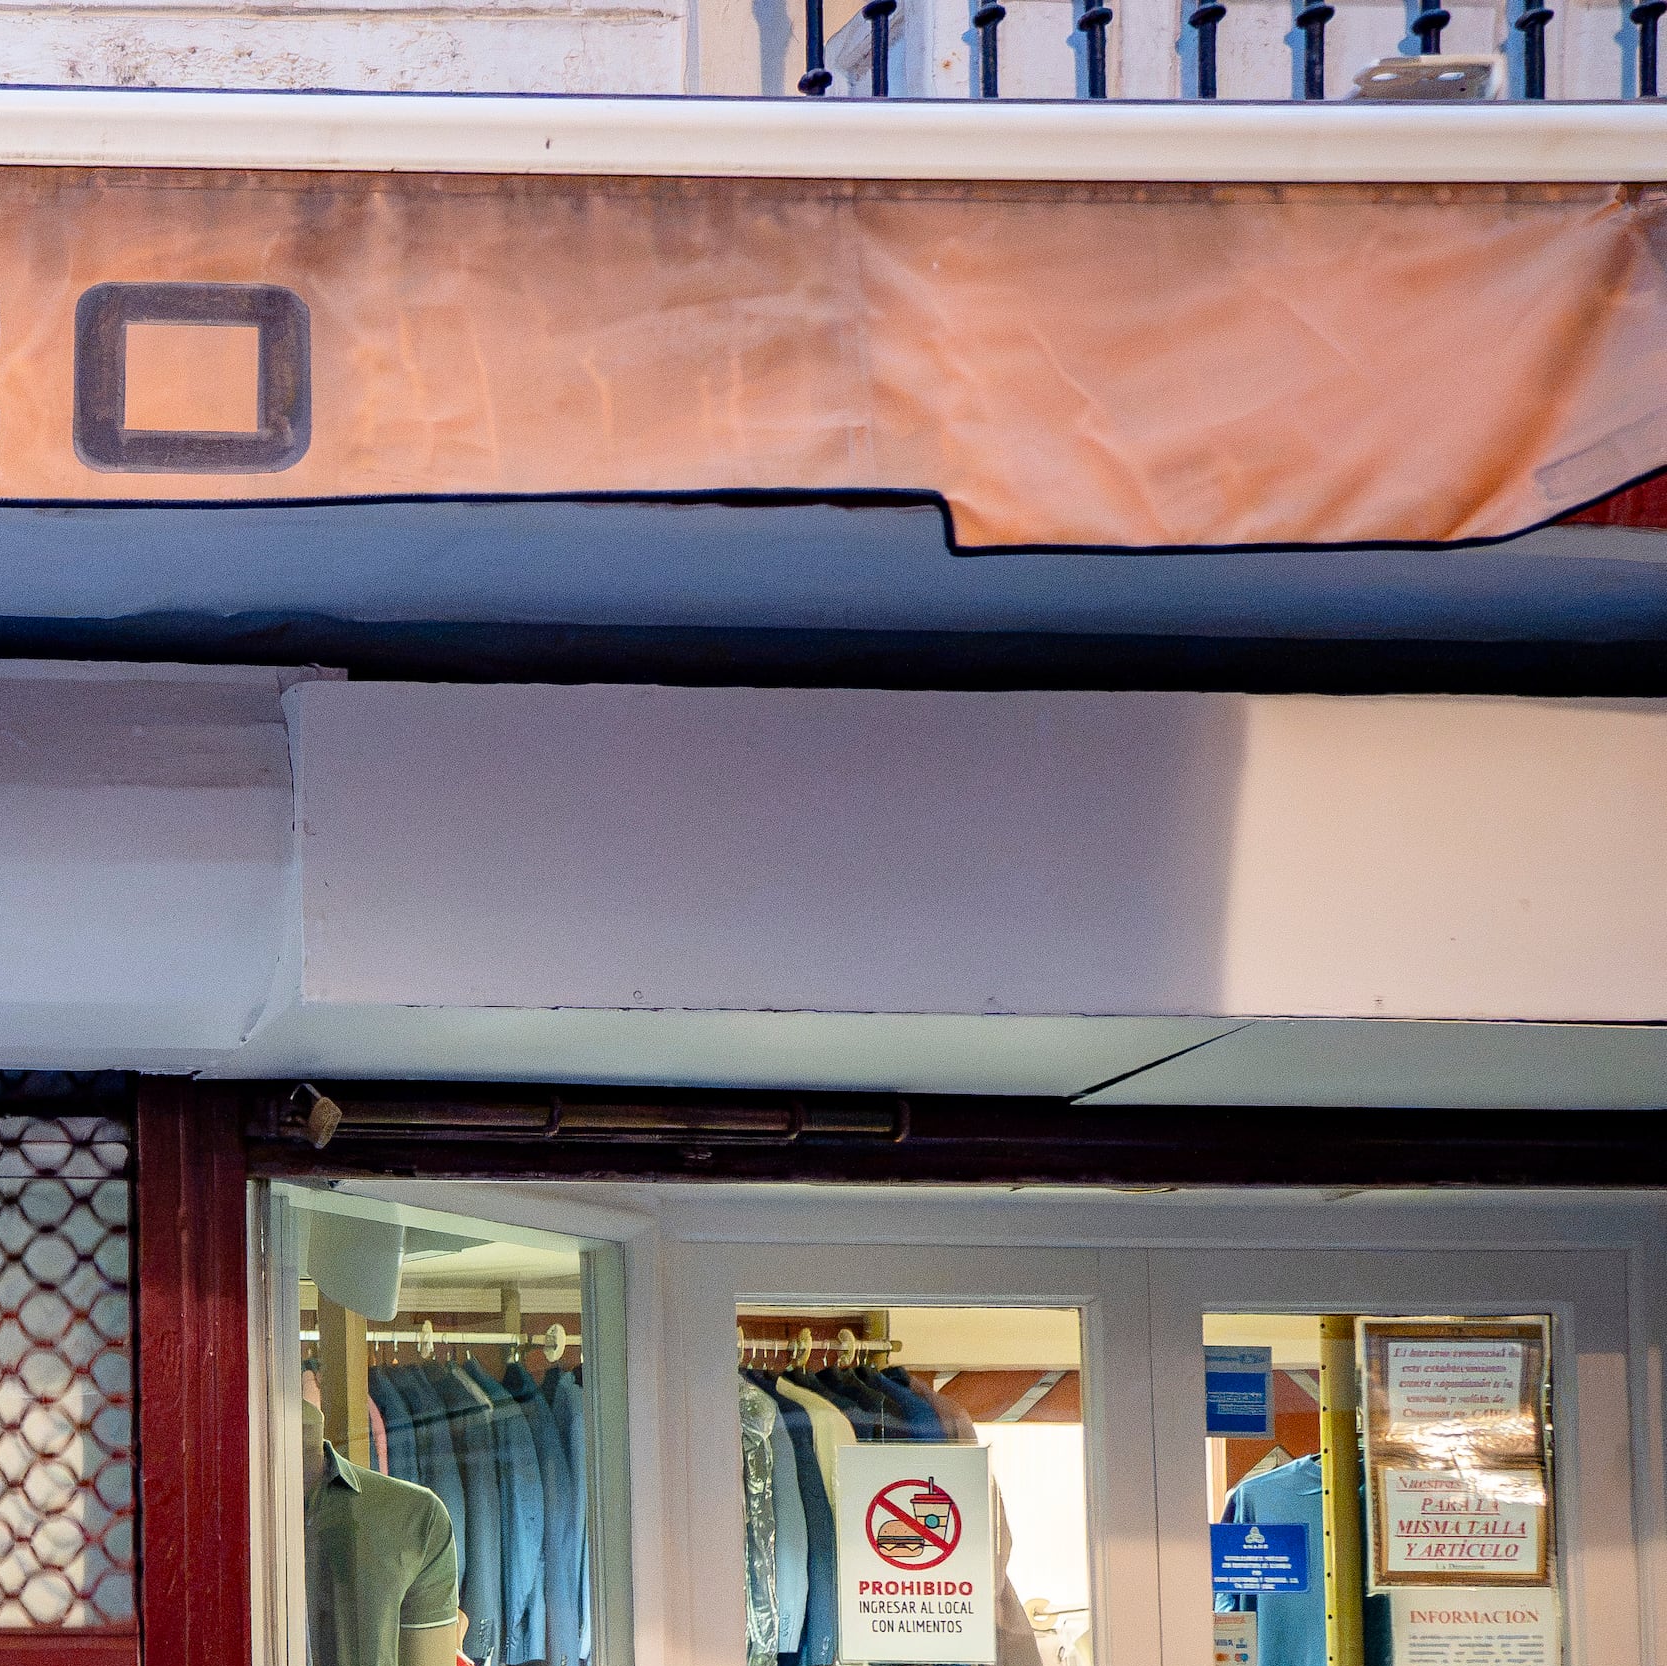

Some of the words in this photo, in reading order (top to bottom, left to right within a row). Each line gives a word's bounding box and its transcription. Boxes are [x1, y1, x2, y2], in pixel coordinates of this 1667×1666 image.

[1421, 1497, 1468, 1511] PARA
[1477, 1498, 1499, 1511] LA
[1397, 1519, 1461, 1534] MISMA
[1468, 1520, 1527, 1534] TALLA
[1407, 1543, 1419, 1557] Y
[859, 1580, 973, 1596] PROHIBIDO
[859, 1600, 916, 1613] INGRESAR
[920, 1601, 935, 1614] AL
[938, 1601, 974, 1614] LOCAL
[871, 1619, 894, 1632] CON
[898, 1619, 963, 1633] ALIMENTOS
